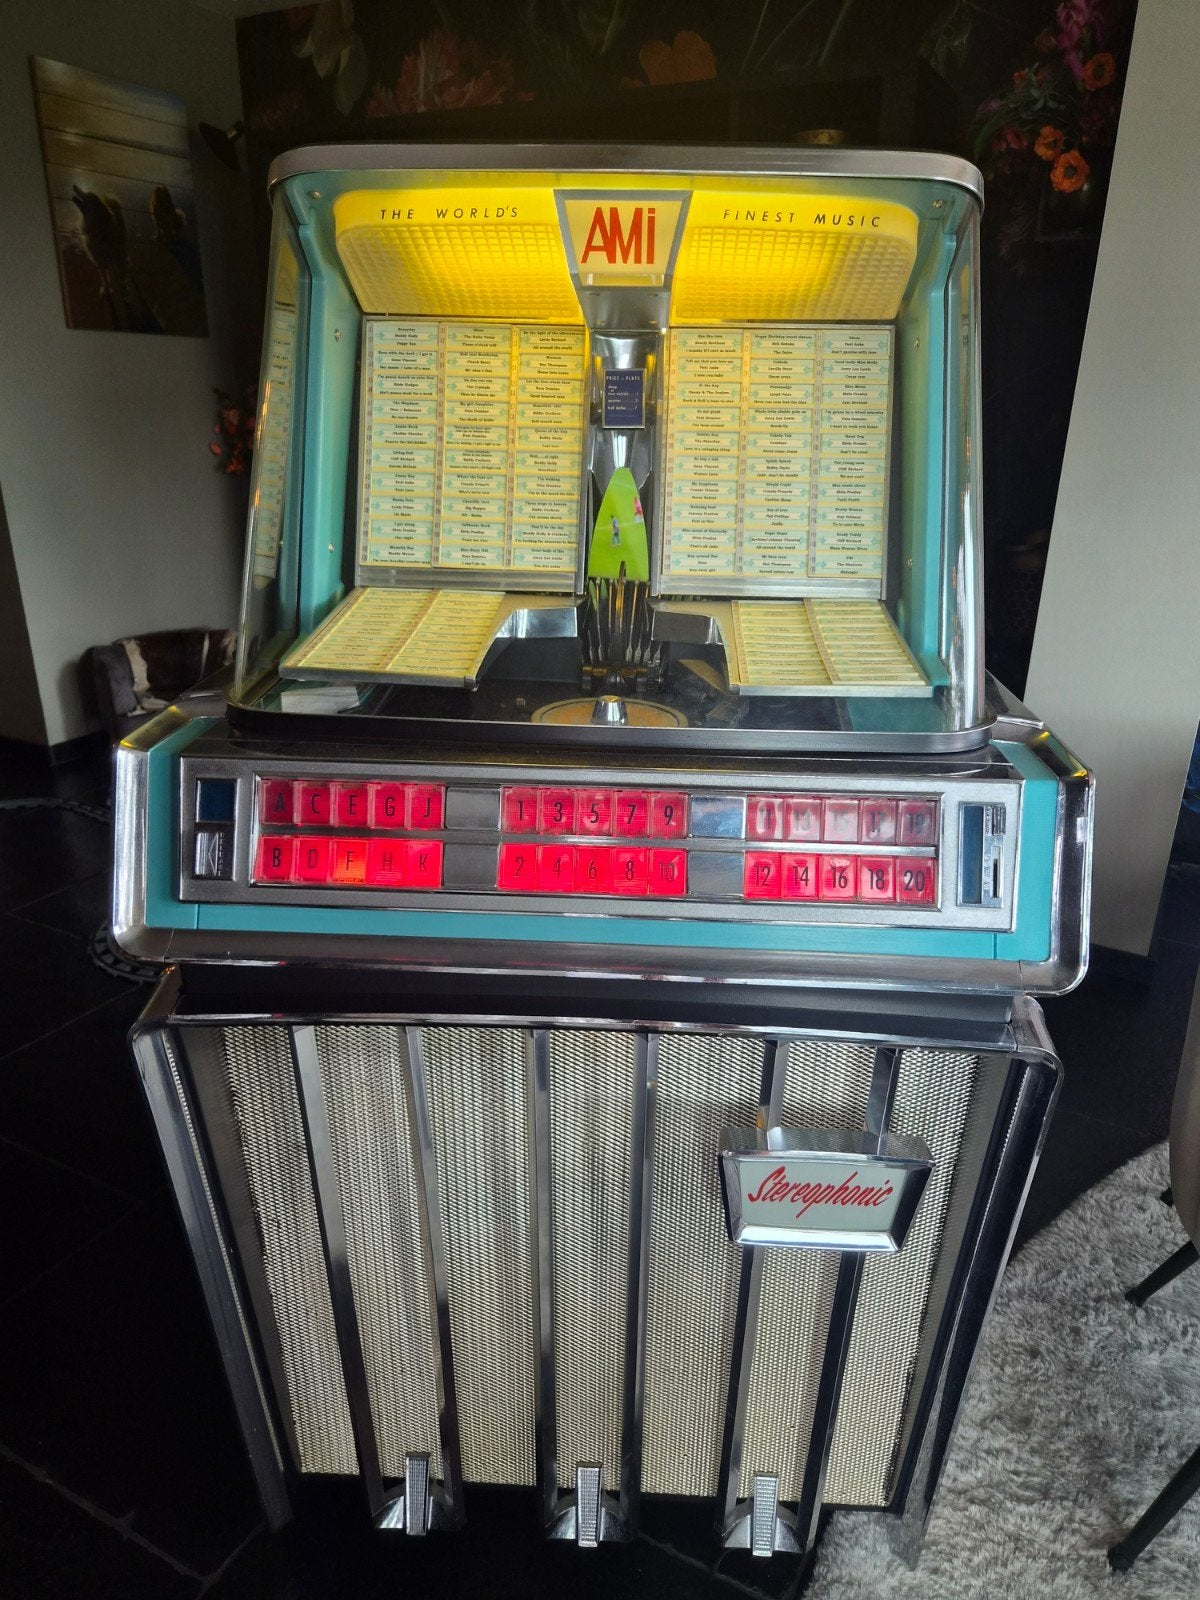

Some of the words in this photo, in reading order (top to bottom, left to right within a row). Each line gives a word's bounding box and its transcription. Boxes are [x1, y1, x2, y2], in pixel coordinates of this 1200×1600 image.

[380, 209, 414, 220] THE
[436, 205, 518, 219] WORLD'S
[723, 209, 796, 223] FINEST
[814, 213, 881, 228] MUSIC
[274, 793, 286, 812] A
[310, 793, 320, 814] C
[349, 794, 357, 816] E
[384, 796, 395, 817] G
[424, 797, 431, 818] J
[518, 800, 524, 821] 1
[553, 801, 563, 822] 3
[590, 803, 600, 824] 5
[626, 804, 636, 825] 7
[664, 805, 674, 826] 9
[908, 812, 926, 834] 19
[272, 848, 281, 868] B
[307, 848, 318, 868] D
[346, 850, 354, 870] F
[382, 852, 393, 872] H
[418, 853, 428, 872] K
[514, 856, 524, 877] 2
[552, 857, 562, 877] 4
[588, 858, 598, 879] 6
[626, 860, 634, 881] 8
[660, 861, 675, 882] 10
[754, 865, 770, 886] 12
[792, 866, 810, 887] 14
[831, 866, 848, 889] 16
[868, 868, 884, 891] 18
[904, 870, 925, 892] 20
[748, 1165, 893, 1219] Stereophonic
